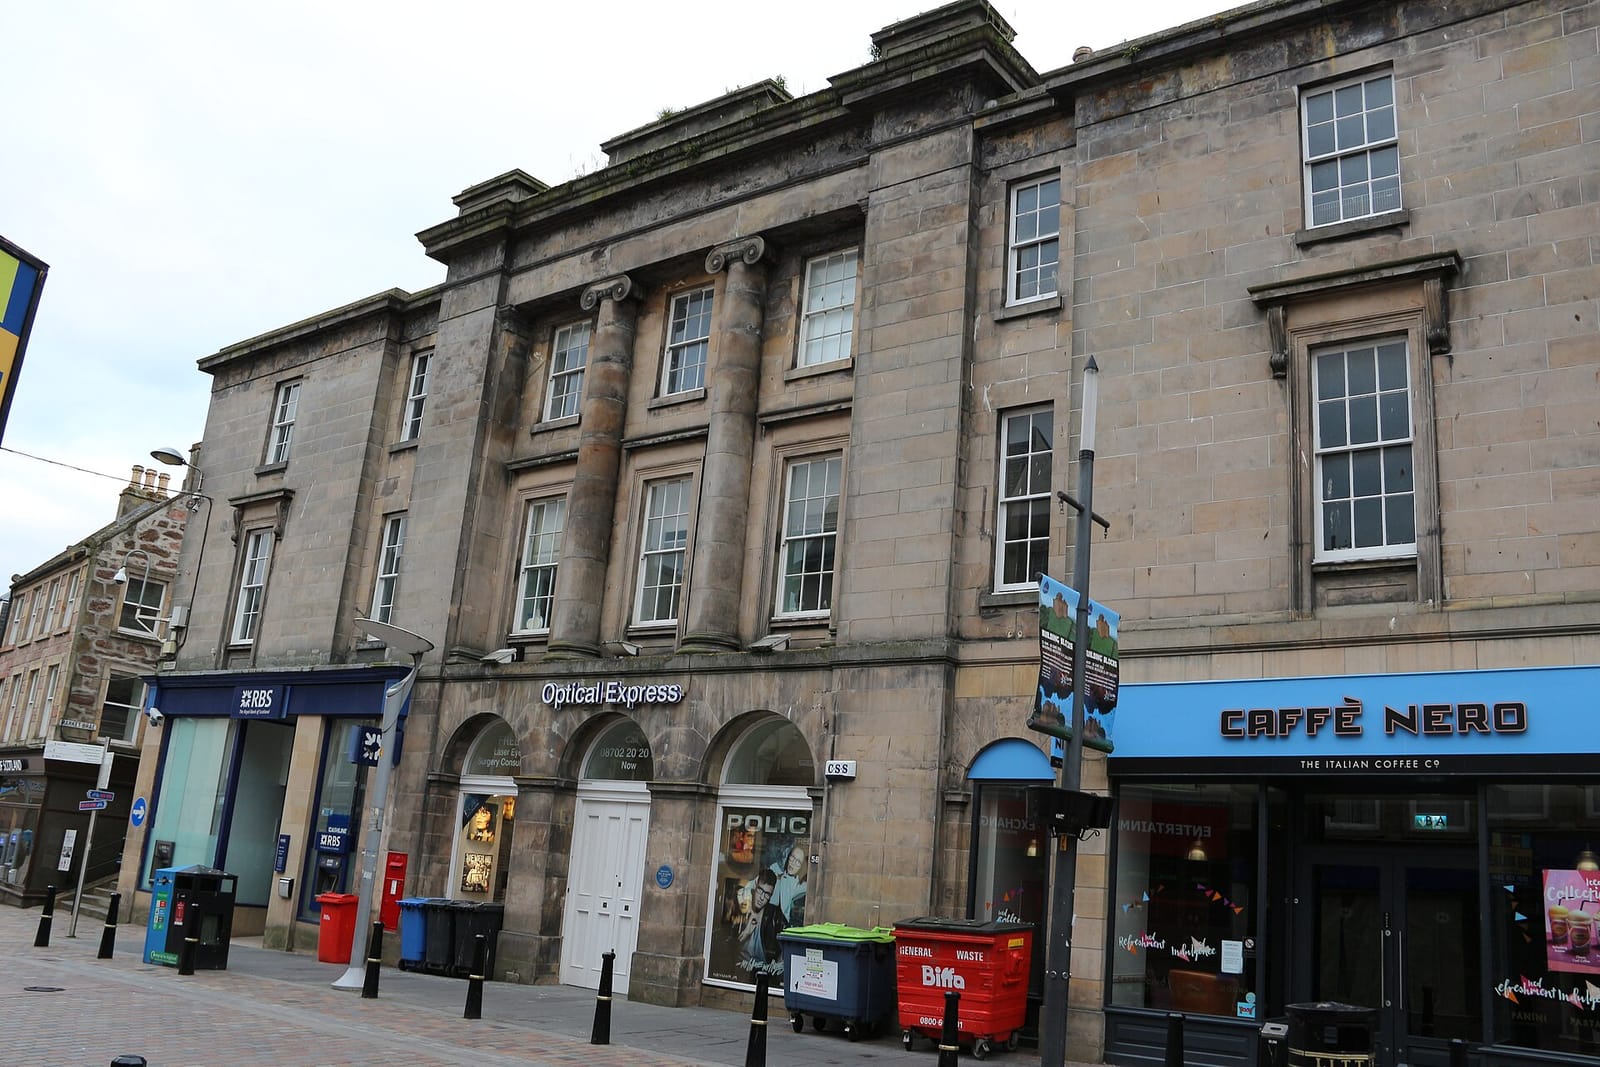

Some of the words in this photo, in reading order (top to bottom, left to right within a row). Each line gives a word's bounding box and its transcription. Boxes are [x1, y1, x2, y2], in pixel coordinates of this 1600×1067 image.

[250, 689, 274, 708] RBS
[541, 681, 603, 709] Optical
[604, 681, 683, 708] Express
[1220, 695, 1363, 736] CAFFÈ
[1384, 702, 1528, 736] NERO
[626, 748, 637, 759] 20
[638, 749, 649, 759] 20
[621, 761, 638, 771] Now
[1300, 760, 1320, 769] THE
[1325, 760, 1369, 769] ITALIAN
[1375, 760, 1419, 769] COFFEE
[327, 835, 341, 847] RBS
[899, 945, 933, 958] GENERAL
[956, 950, 984, 962] WASTE
[921, 964, 966, 990] Biffa
